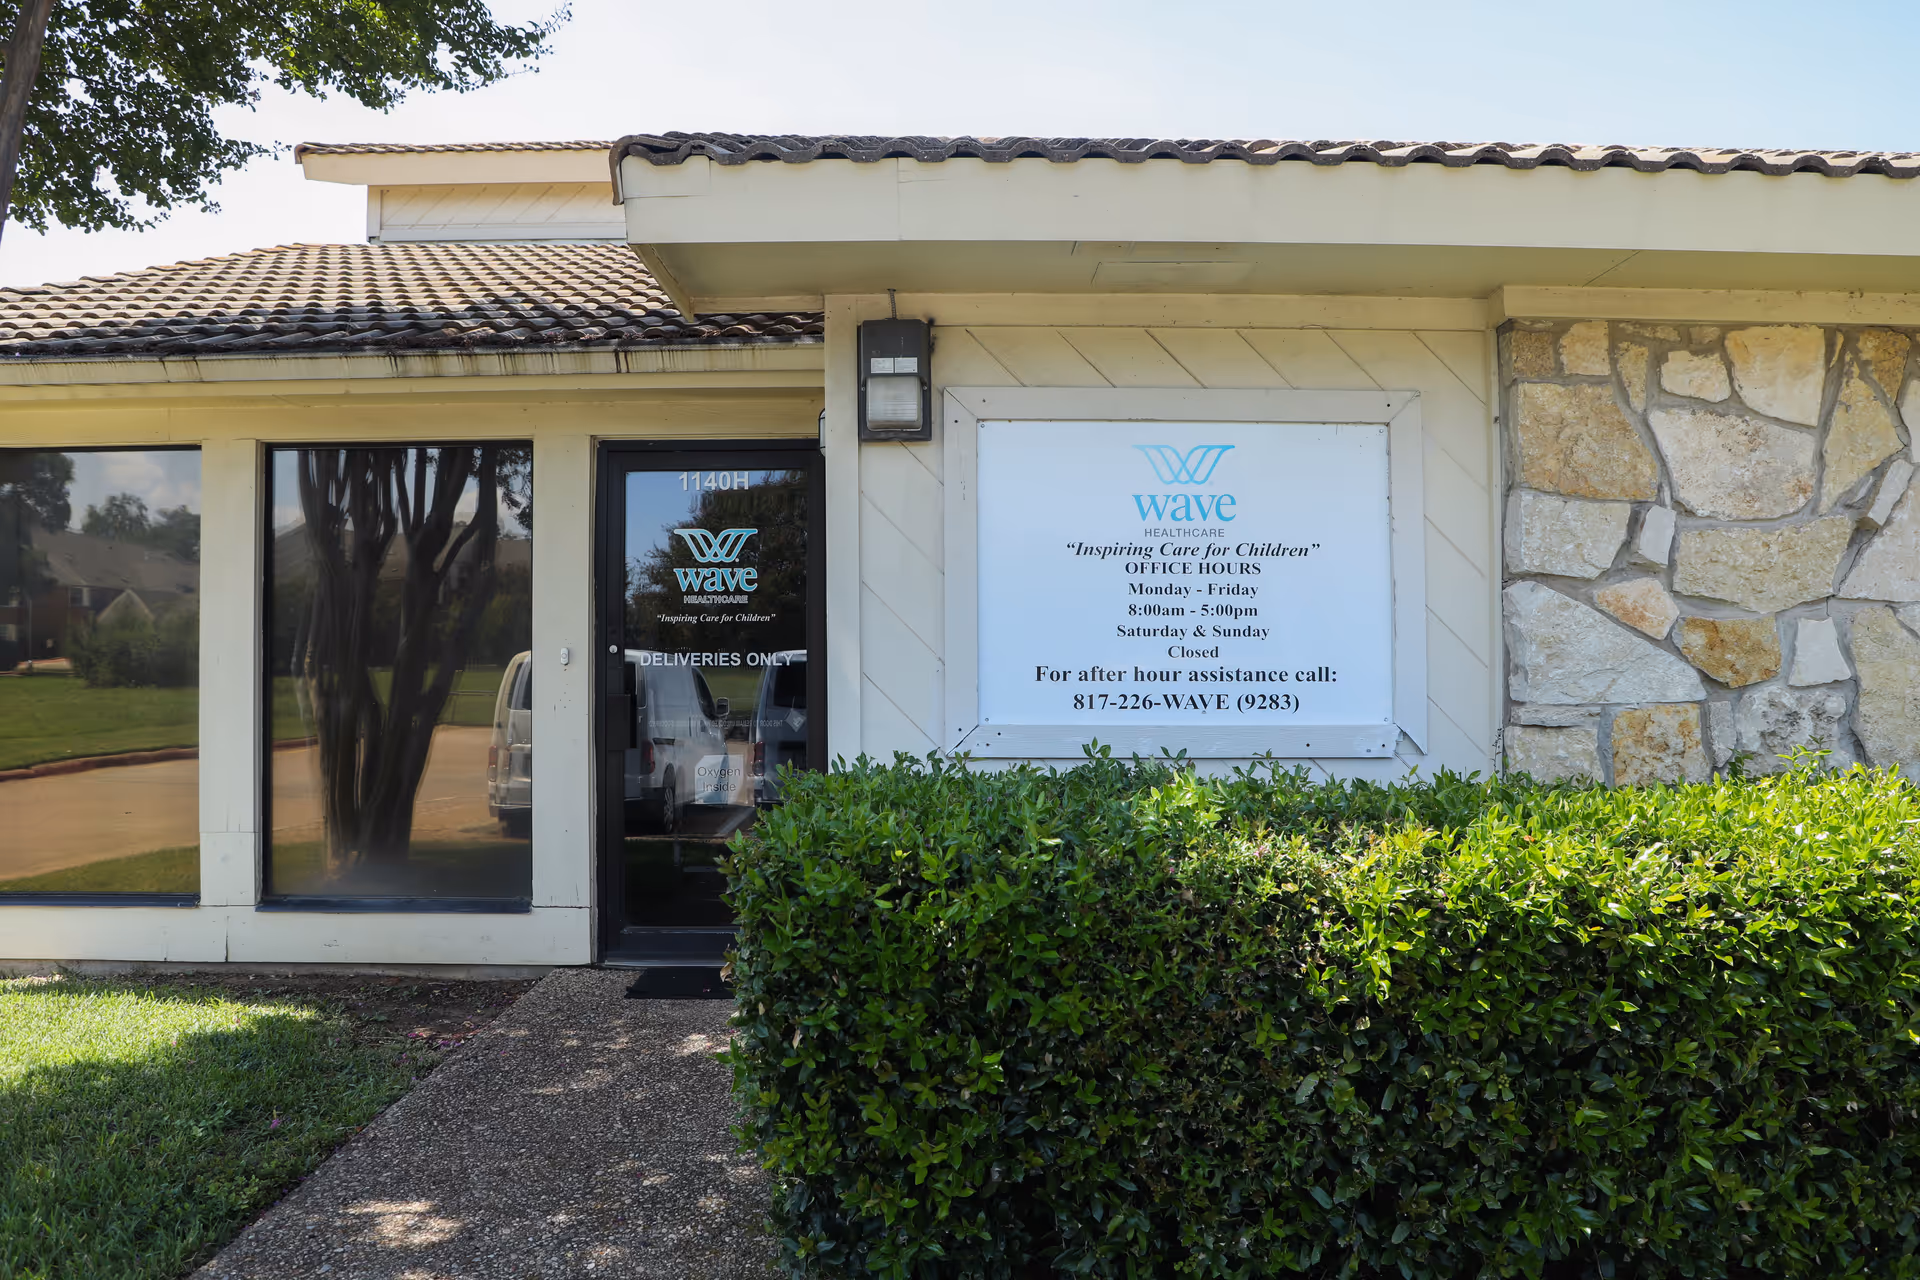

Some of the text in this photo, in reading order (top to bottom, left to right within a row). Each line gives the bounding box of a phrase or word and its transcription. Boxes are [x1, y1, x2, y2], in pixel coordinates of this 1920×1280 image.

[678, 471, 748, 490] 1140H
[1132, 493, 1236, 521] wave
[1144, 528, 1224, 537] HEALTHCARE
[1159, 542, 1199, 556] Care
[1201, 542, 1230, 559] for
[1124, 561, 1261, 575] OFFICE HOURS
[673, 567, 757, 591] wave
[1128, 582, 1191, 597] Monday
[1207, 582, 1258, 597] Friday
[683, 595, 748, 603] HEALTHCARE
[719, 614, 733, 622] for
[1128, 603, 1184, 616] 8:00am
[1200, 603, 1257, 619] 5:00pm
[1116, 624, 1269, 639] Saturday & Sunday
[640, 652, 792, 665] DELIVERIES ONLY
[1167, 645, 1219, 658] Closed
[1035, 665, 1337, 681] For after hour assistance call:
[1072, 693, 1299, 712] 817-226-WAVE (9283)
[697, 766, 740, 778] Oxygen
[702, 781, 736, 791] Inside
